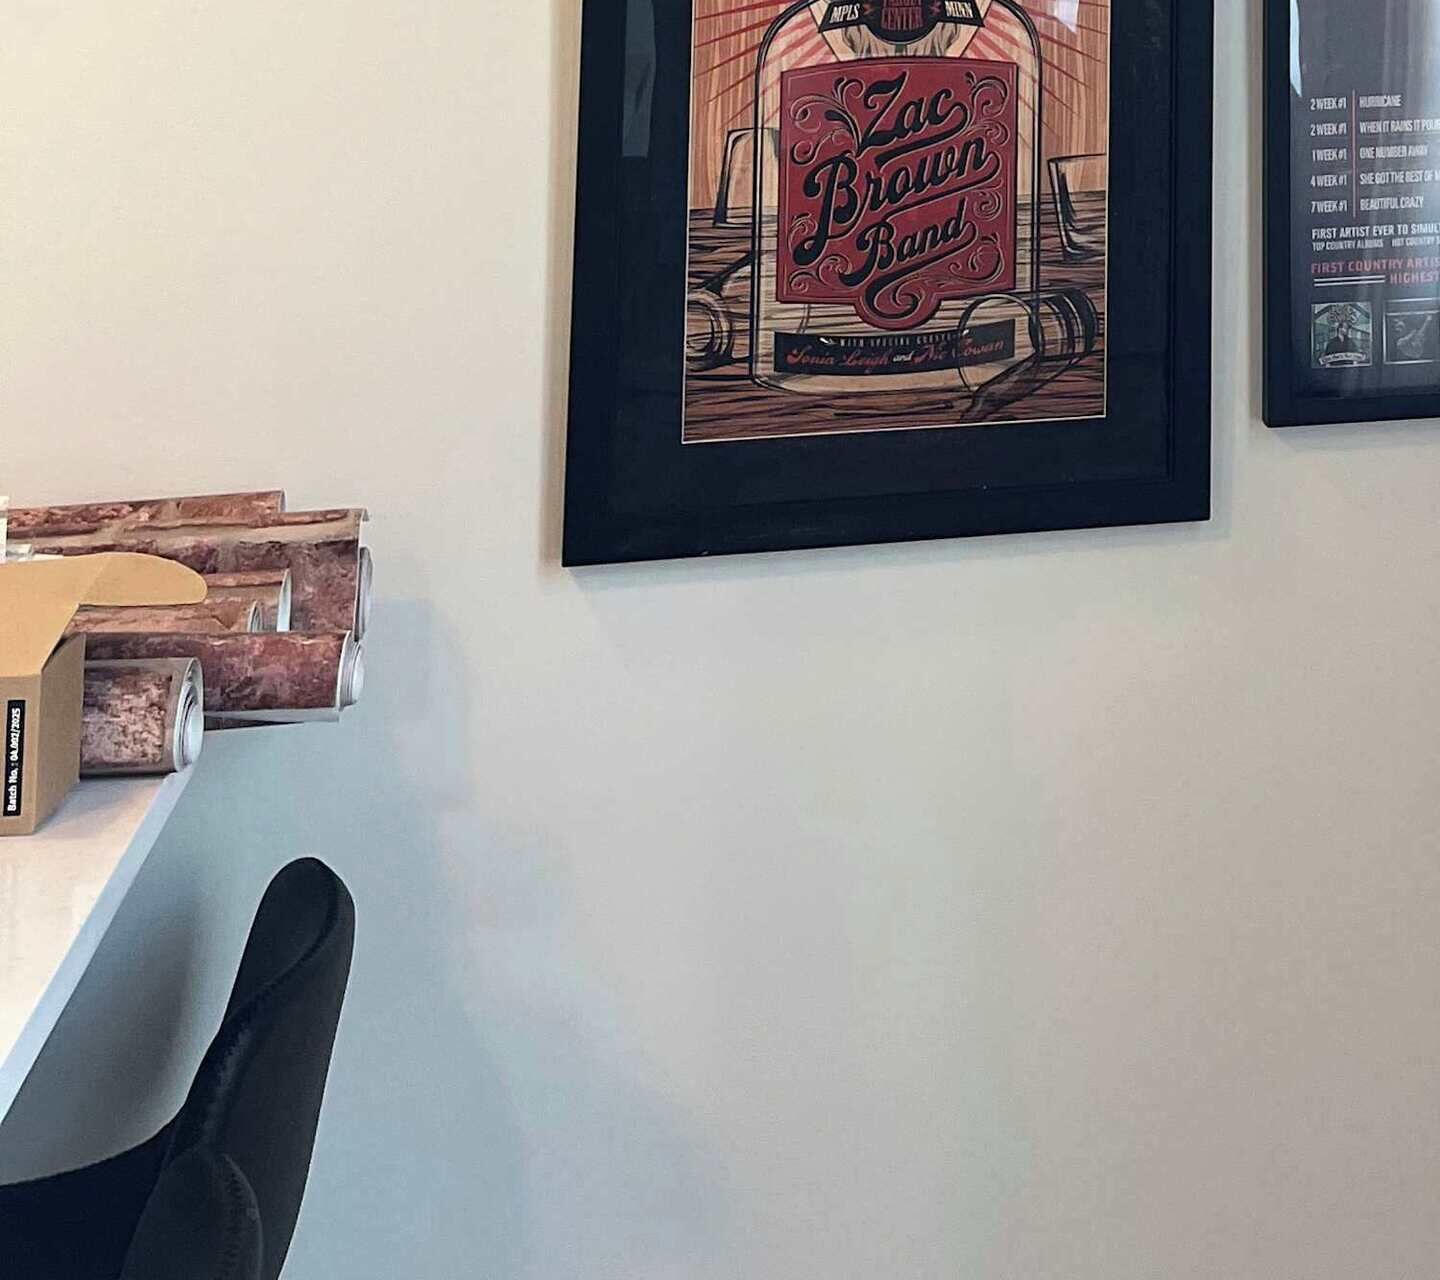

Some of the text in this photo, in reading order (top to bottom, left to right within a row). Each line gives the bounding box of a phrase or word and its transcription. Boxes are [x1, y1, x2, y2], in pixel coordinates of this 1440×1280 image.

[829, 2, 860, 24] MPLS
[944, 0, 973, 19] MINN
[880, 6, 924, 31] CENTER
[1316, 96, 1338, 110] WEEK
[857, 70, 967, 162] Zac
[1316, 123, 1338, 136] WEEK
[1316, 148, 1338, 161] WEEK
[1316, 174, 1338, 187] WEEK
[792, 137, 1000, 266] Brown
[1316, 200, 1339, 213] WEEK
[1311, 228, 1337, 240] FIRST
[1339, 226, 1370, 238] ARTIST
[1372, 225, 1395, 237] EVER
[1397, 224, 1410, 236] TO
[838, 197, 977, 289] Band
[1311, 261, 1347, 274] FIRST
[1349, 258, 1403, 272] COUNTRY
[7, 784, 17, 812] Batch
